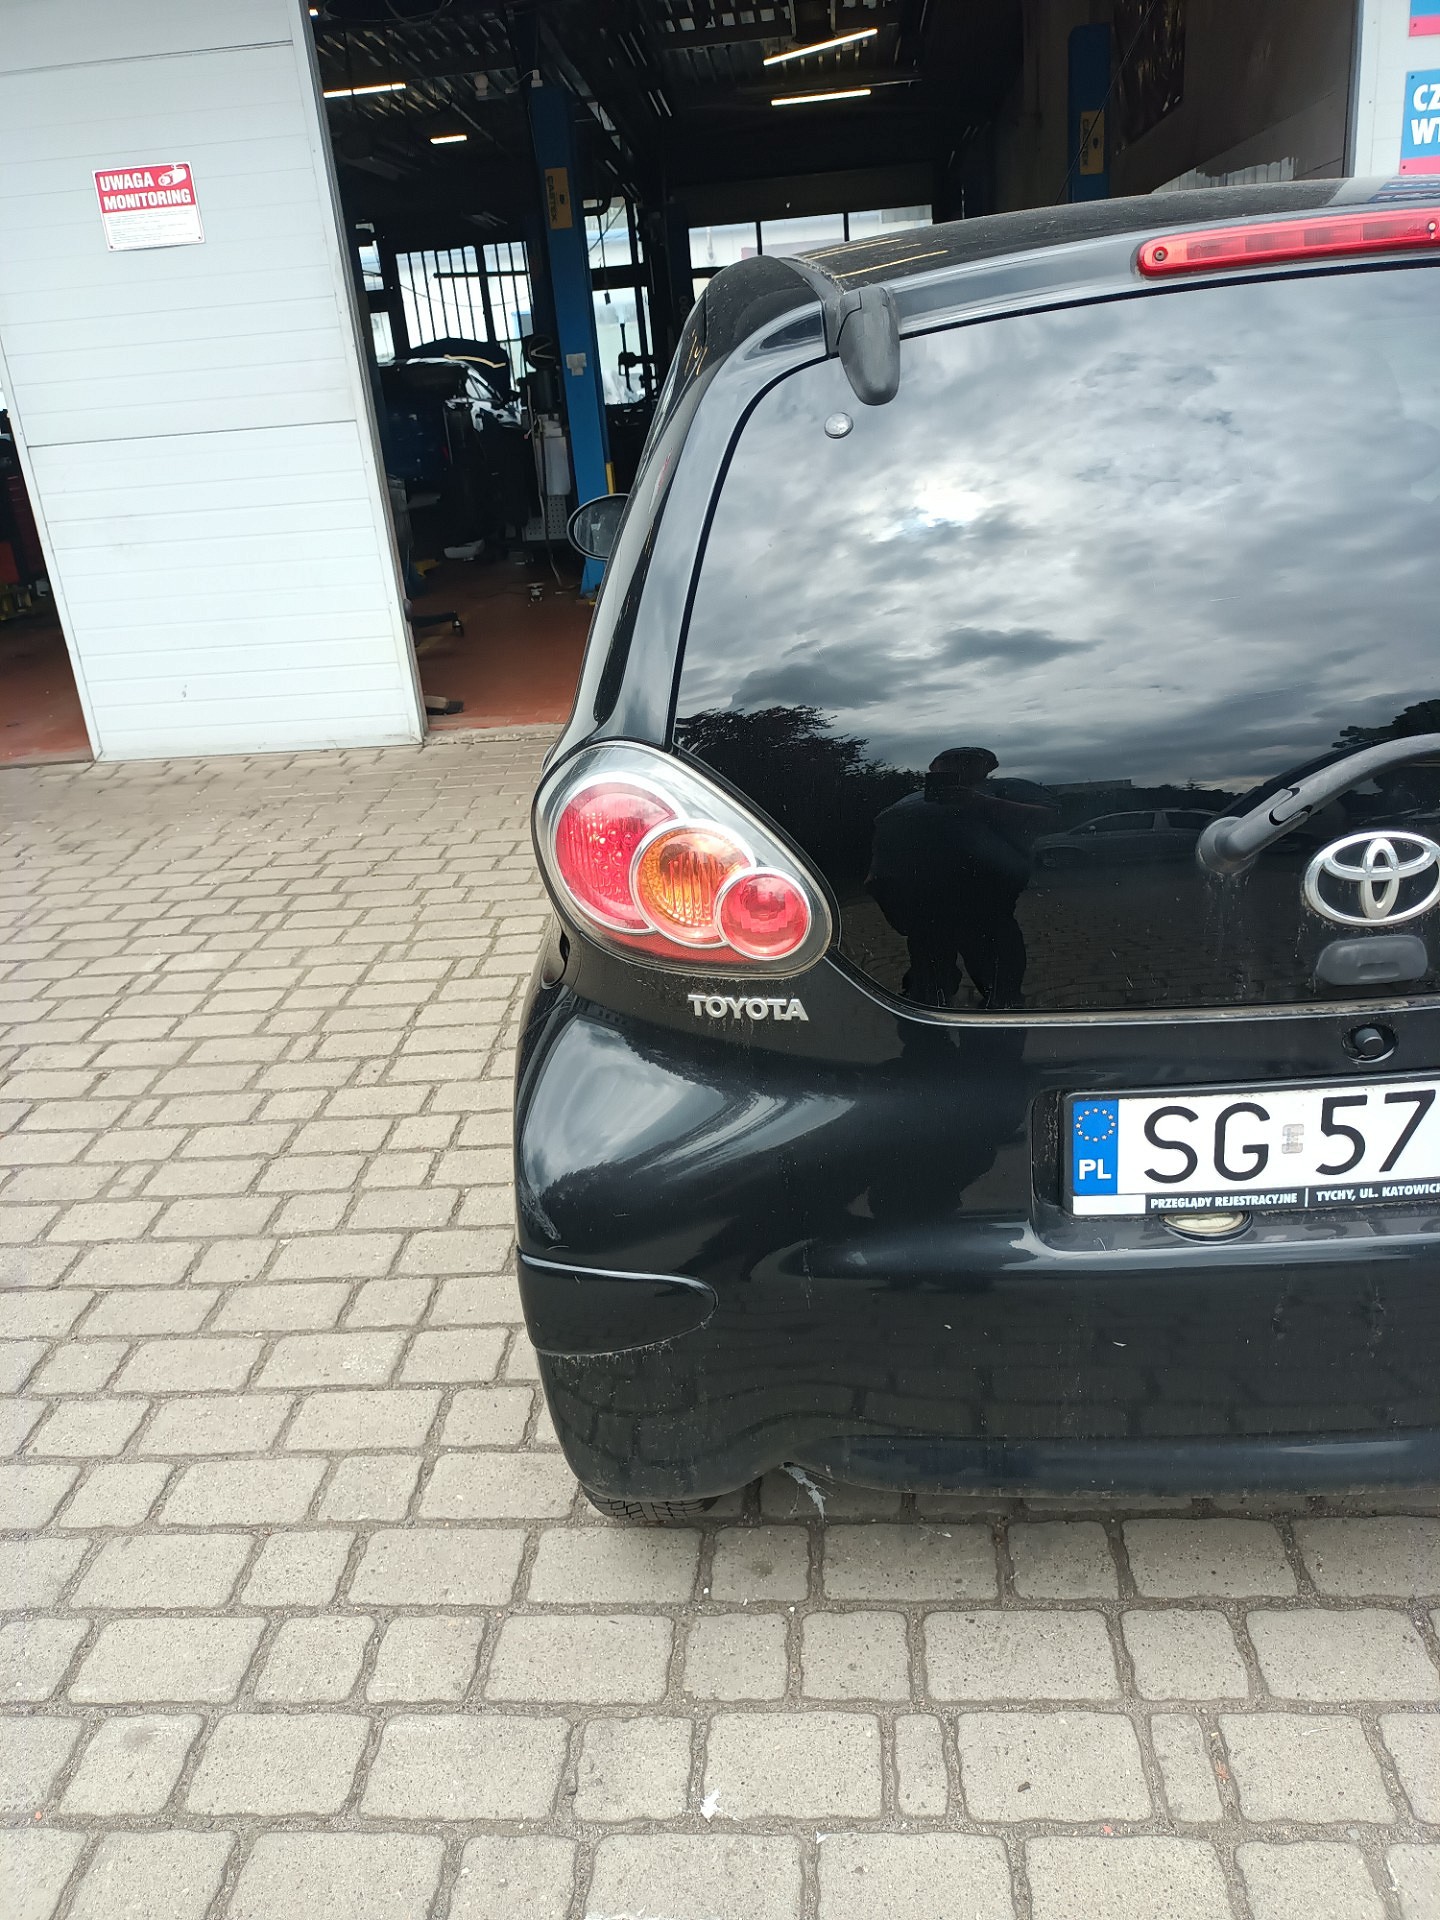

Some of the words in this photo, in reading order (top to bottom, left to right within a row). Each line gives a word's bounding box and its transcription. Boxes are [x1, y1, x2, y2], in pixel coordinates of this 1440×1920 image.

[99, 171, 155, 192] UWAGA
[103, 188, 192, 211] MONITORING
[687, 994, 809, 1021] TOYOTA
[1143, 1101, 1271, 1184] SG
[1315, 1089, 1437, 1176] 57
[1078, 1158, 1112, 1180] PL
[1150, 1196, 1213, 1209] PRZEGLĄDY
[1215, 1192, 1298, 1207] REJESTRACYJNE
[1316, 1189, 1357, 1202] TYCHY,
[1359, 1187, 1379, 1199] UL.
